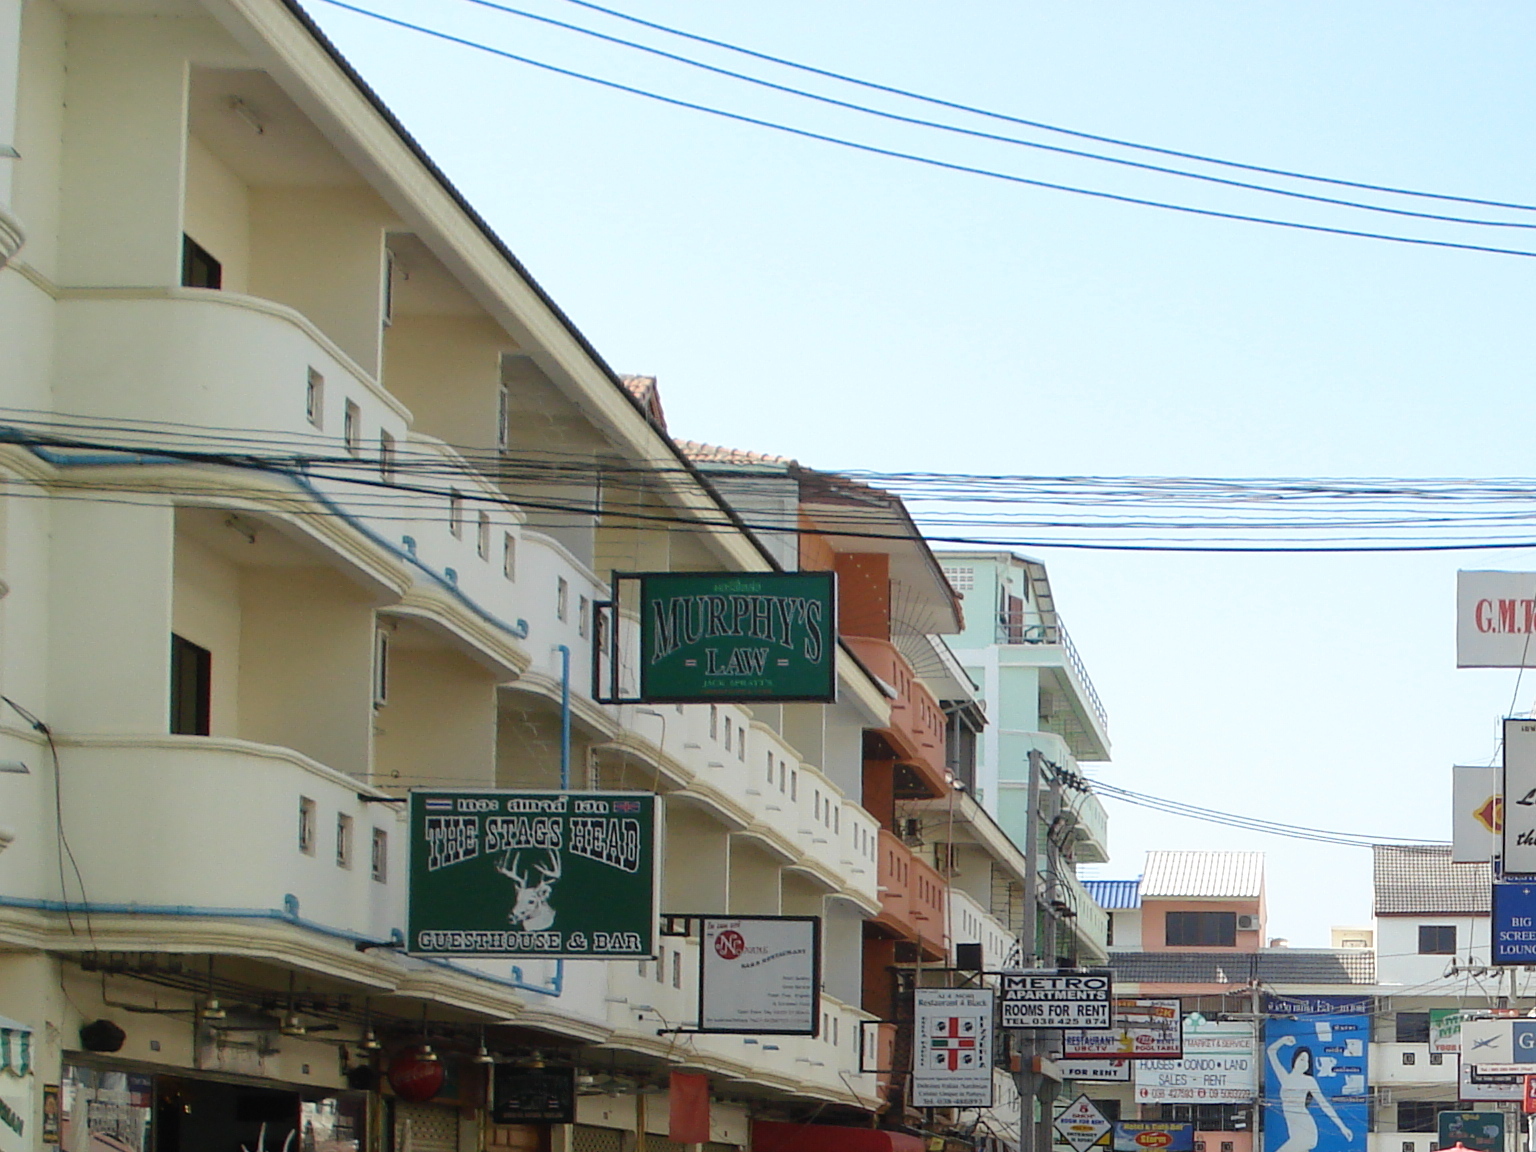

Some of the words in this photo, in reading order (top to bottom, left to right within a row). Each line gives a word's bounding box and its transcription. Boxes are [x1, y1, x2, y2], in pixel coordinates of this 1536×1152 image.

[652, 595, 822, 664] MURPHY'S
[705, 647, 769, 676] LAW
[425, 816, 478, 871] THE
[485, 816, 563, 853] STAGS
[569, 817, 641, 873] HEAD
[1511, 917, 1532, 927] BIG
[418, 931, 562, 951] GUESTHOUSE
[566, 932, 588, 950] &
[593, 932, 642, 951] BAR
[1007, 978, 1106, 989] METRO
[1006, 990, 1106, 1000] APARTMENTS
[1004, 1004, 1044, 1017] ROOMS
[1048, 1004, 1070, 1017] FOR
[1077, 1004, 1107, 1017] RENT
[1066, 1036, 1115, 1046] RESTAURANT
[1140, 1059, 1175, 1070] HOUSES
[1184, 1059, 1215, 1071] CONDO
[1224, 1059, 1248, 1071] LAND
[1069, 1069, 1089, 1077] FOR
[1093, 1069, 1118, 1077] RENT
[1159, 1074, 1187, 1086] SALES
[1203, 1075, 1227, 1086] RENT
